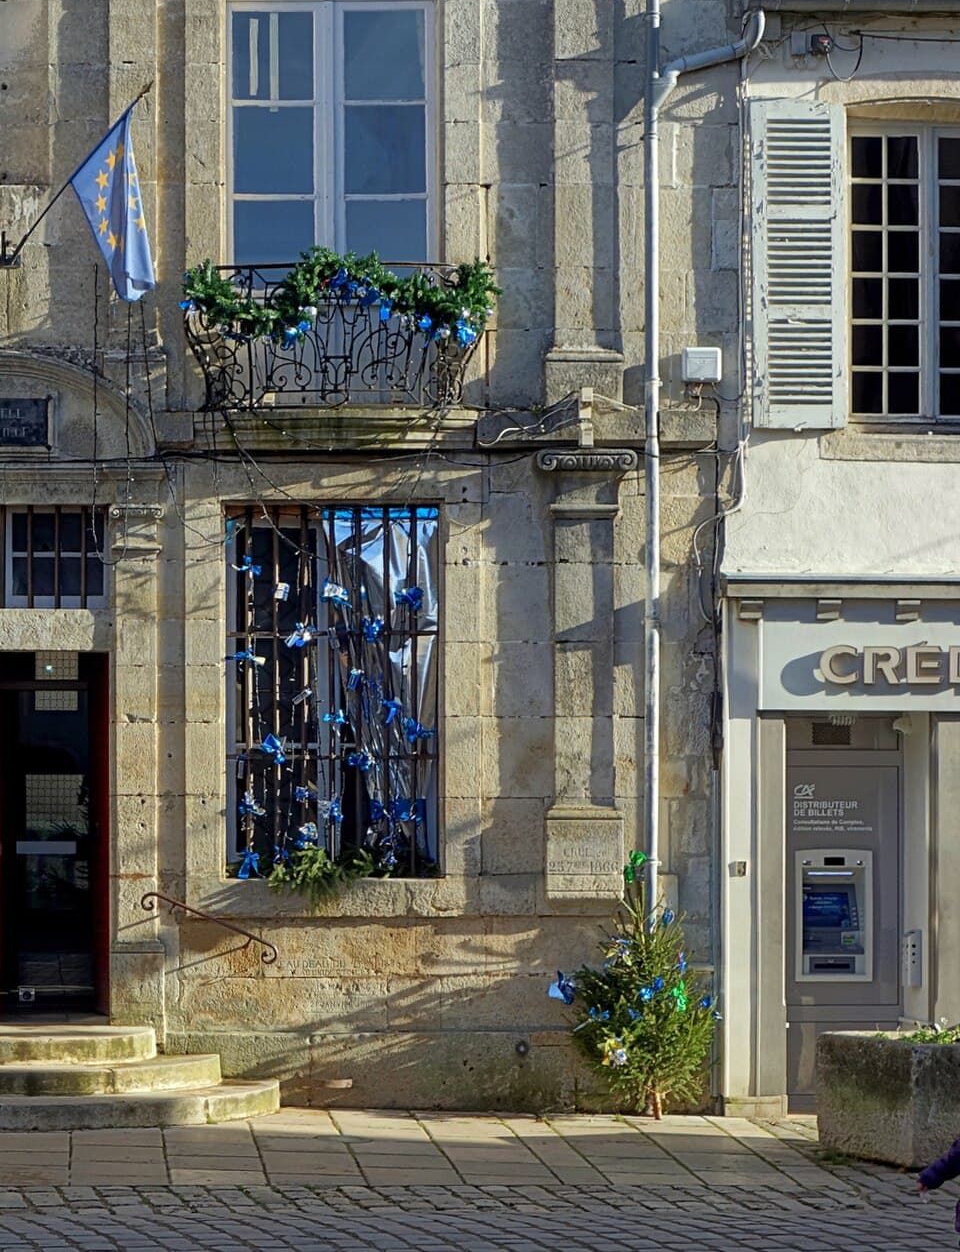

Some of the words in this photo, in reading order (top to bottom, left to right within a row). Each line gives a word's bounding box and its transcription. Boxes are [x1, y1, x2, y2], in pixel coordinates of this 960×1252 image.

[793, 800, 858, 809] DISTRIBUTEUR
[793, 808, 806, 817] DE
[807, 808, 845, 817] BILLETS
